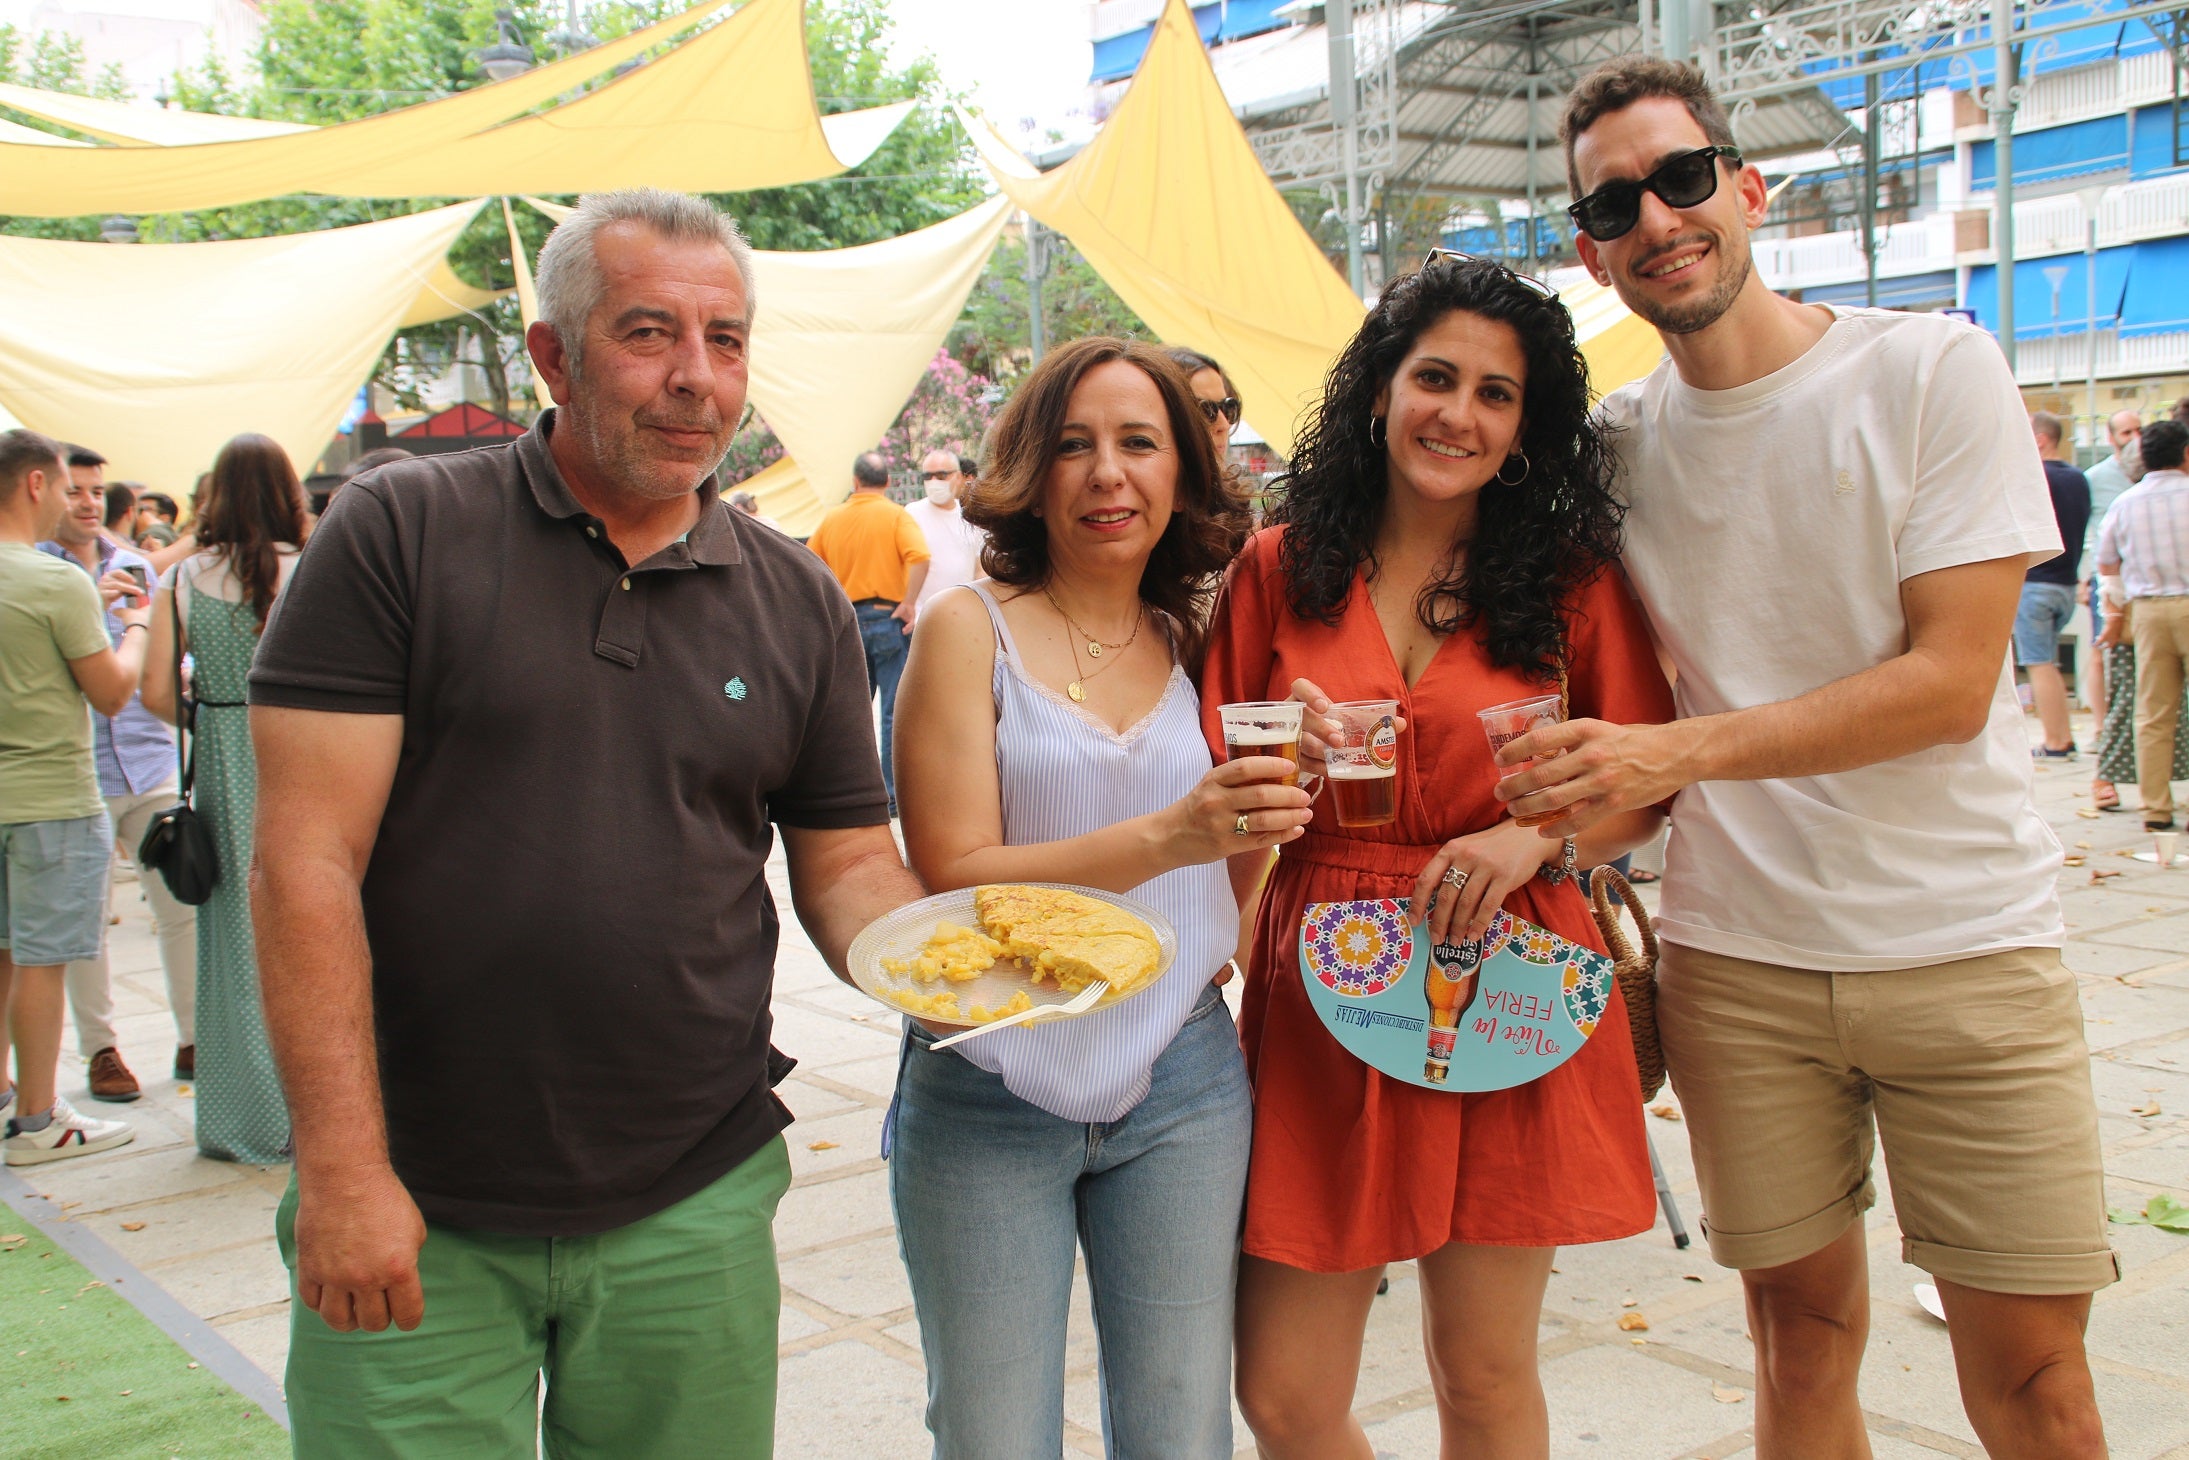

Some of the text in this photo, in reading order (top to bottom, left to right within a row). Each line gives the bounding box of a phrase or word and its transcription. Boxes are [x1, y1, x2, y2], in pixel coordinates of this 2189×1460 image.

[1436, 946, 1478, 964] Estrella
[1484, 987, 1554, 1022] FERIA
[1471, 1017, 1498, 1044] la
[1500, 1026, 1561, 1056] Vive
